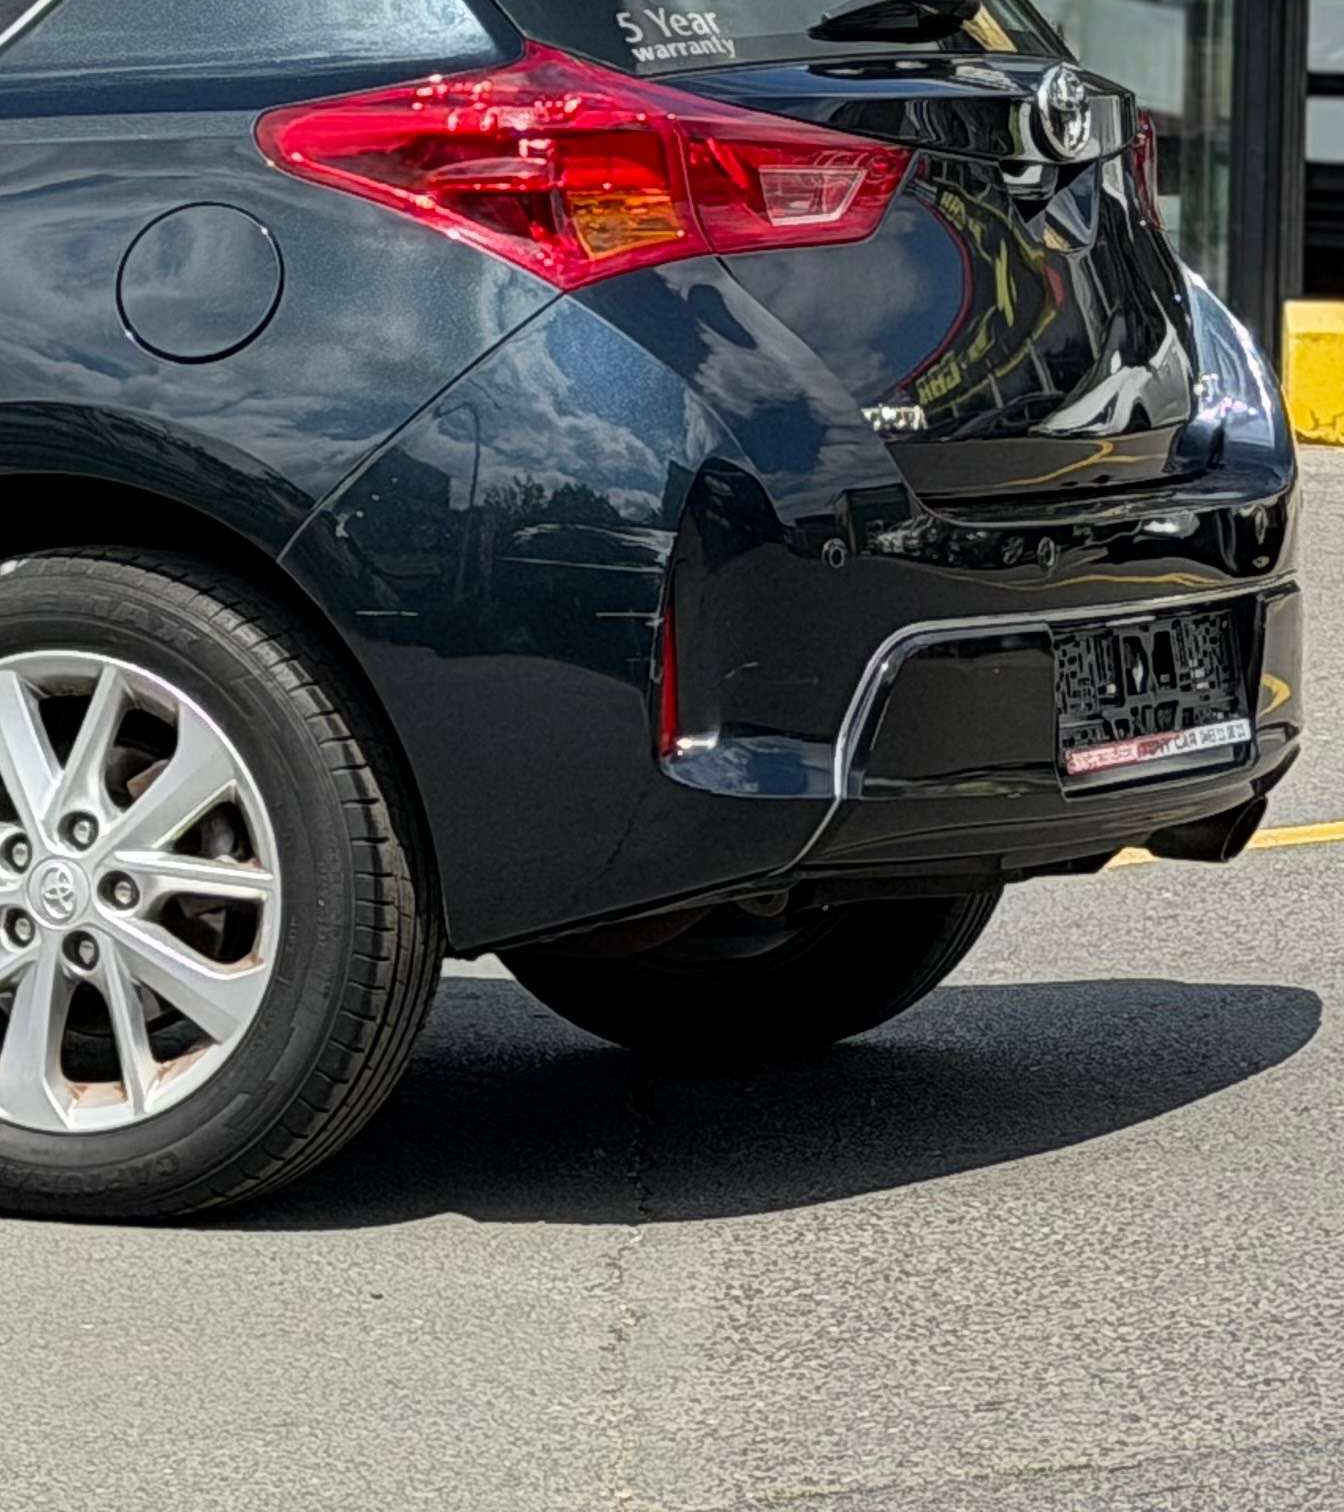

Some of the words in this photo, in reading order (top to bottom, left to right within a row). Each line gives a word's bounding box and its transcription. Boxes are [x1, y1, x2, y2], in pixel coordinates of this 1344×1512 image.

[615, 11, 644, 44] 5
[643, 7, 721, 38] Year
[630, 35, 736, 62] warranty
